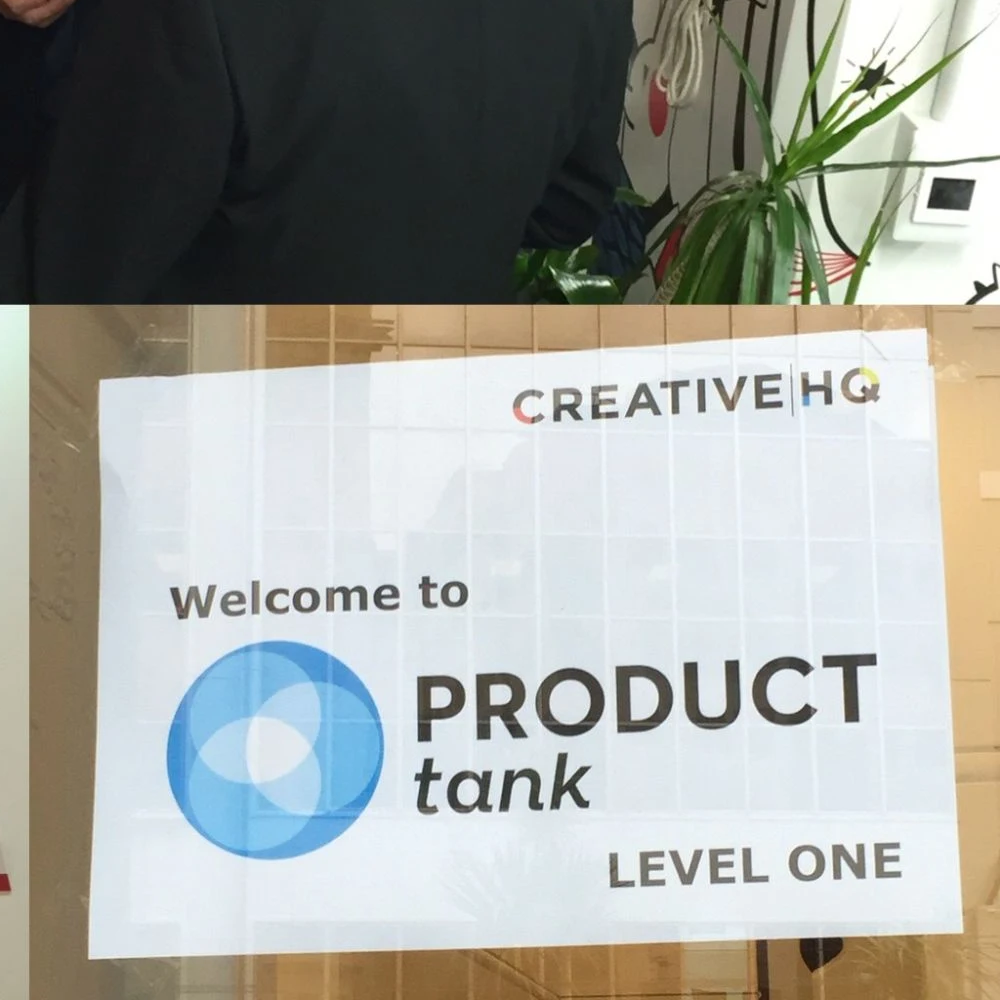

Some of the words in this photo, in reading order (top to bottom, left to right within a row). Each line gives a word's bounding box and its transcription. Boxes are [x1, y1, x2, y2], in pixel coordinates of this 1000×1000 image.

[512, 371, 785, 427] CREATIVE
[800, 366, 882, 408] HQ
[169, 575, 403, 621] Welcome
[417, 573, 470, 611] to
[415, 652, 878, 744] PRODUCT
[413, 750, 593, 815] tank
[607, 845, 769, 890] LEVEL
[787, 840, 904, 883] ONE
